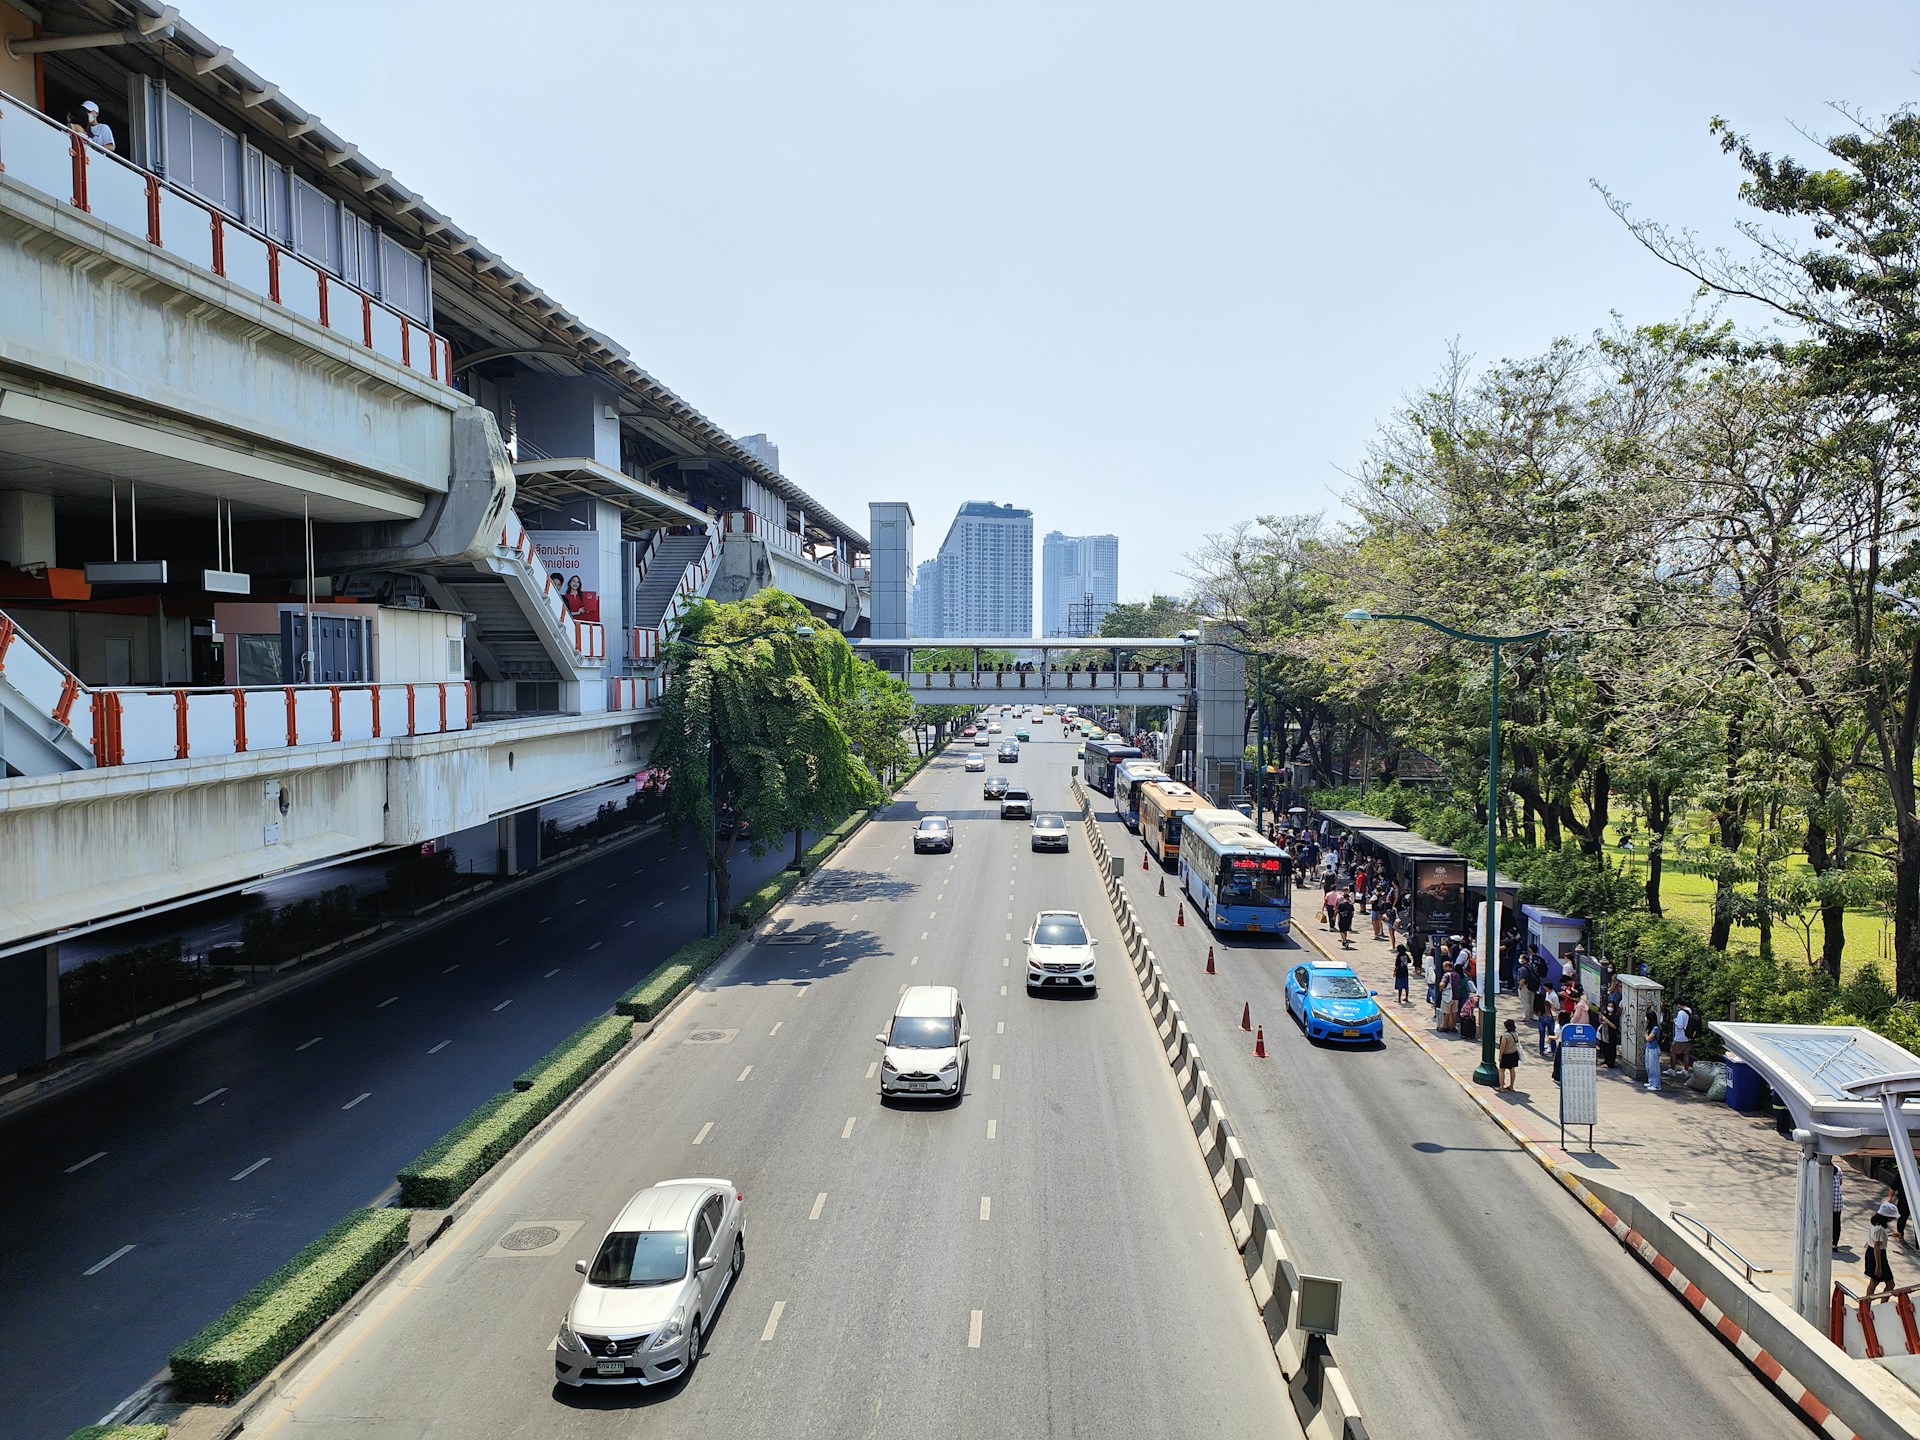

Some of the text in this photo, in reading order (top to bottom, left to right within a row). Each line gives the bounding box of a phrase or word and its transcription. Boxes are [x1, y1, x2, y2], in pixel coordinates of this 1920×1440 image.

[535, 544, 579, 555] ลือกประกัน
[542, 556, 579, 568] อกเอไอเอ
